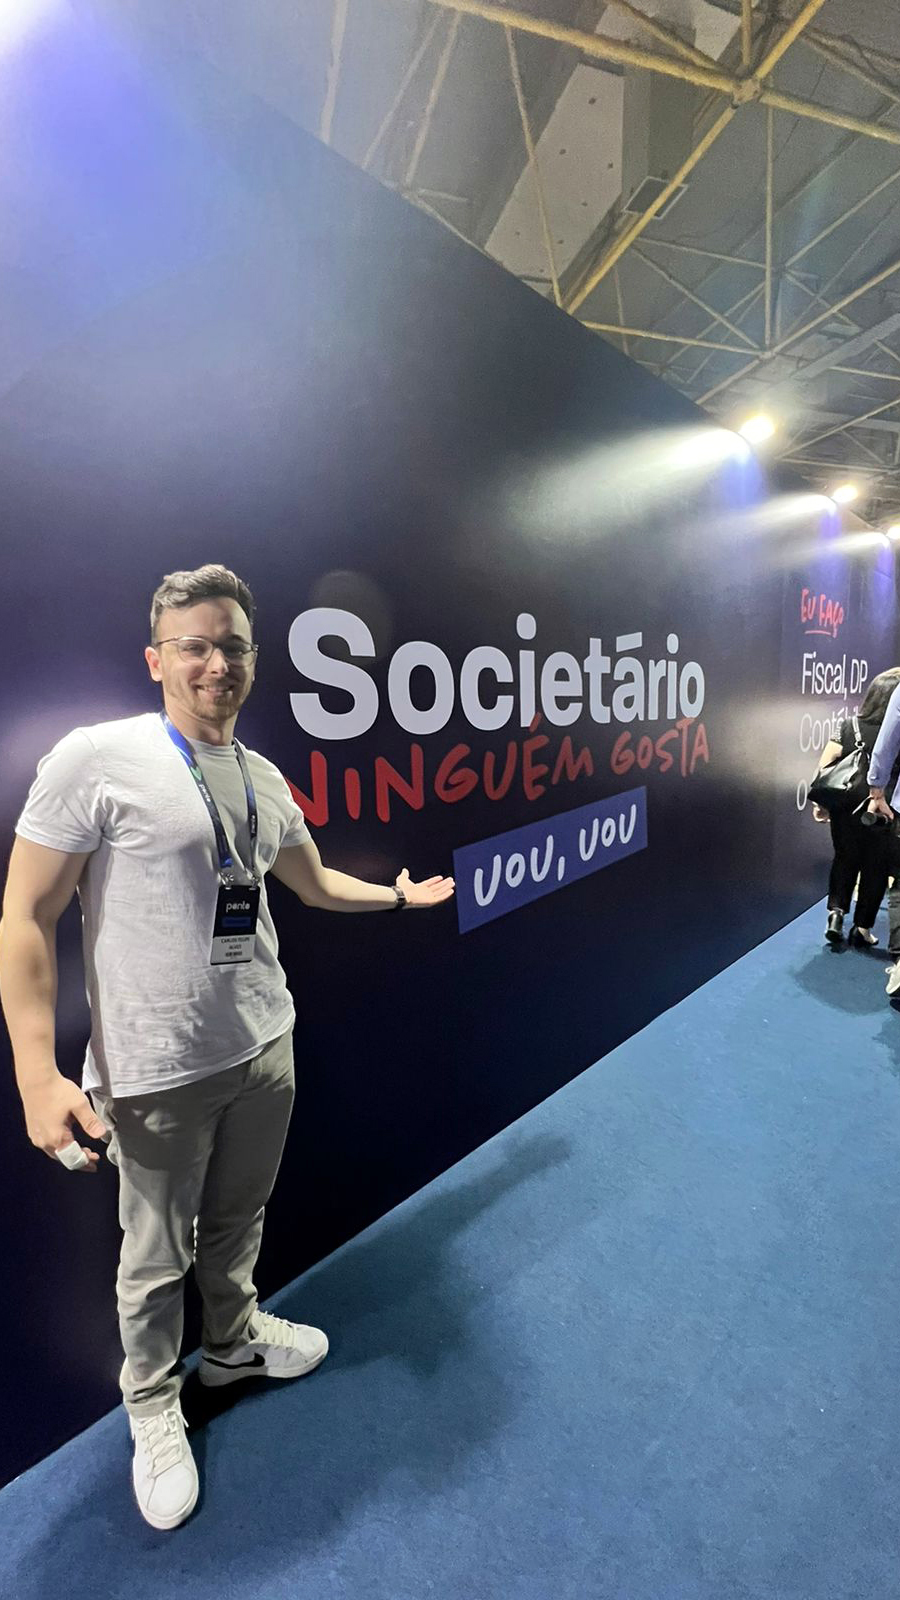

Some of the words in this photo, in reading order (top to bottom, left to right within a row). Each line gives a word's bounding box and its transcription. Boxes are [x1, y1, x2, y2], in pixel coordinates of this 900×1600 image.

[801, 588, 816, 623] EU
[288, 607, 705, 740] Societário
[802, 651, 848, 700] Fiscal,
[850, 659, 868, 694] DP
[283, 712, 594, 827] NINGUÉM
[610, 718, 710, 778] GOSTA
